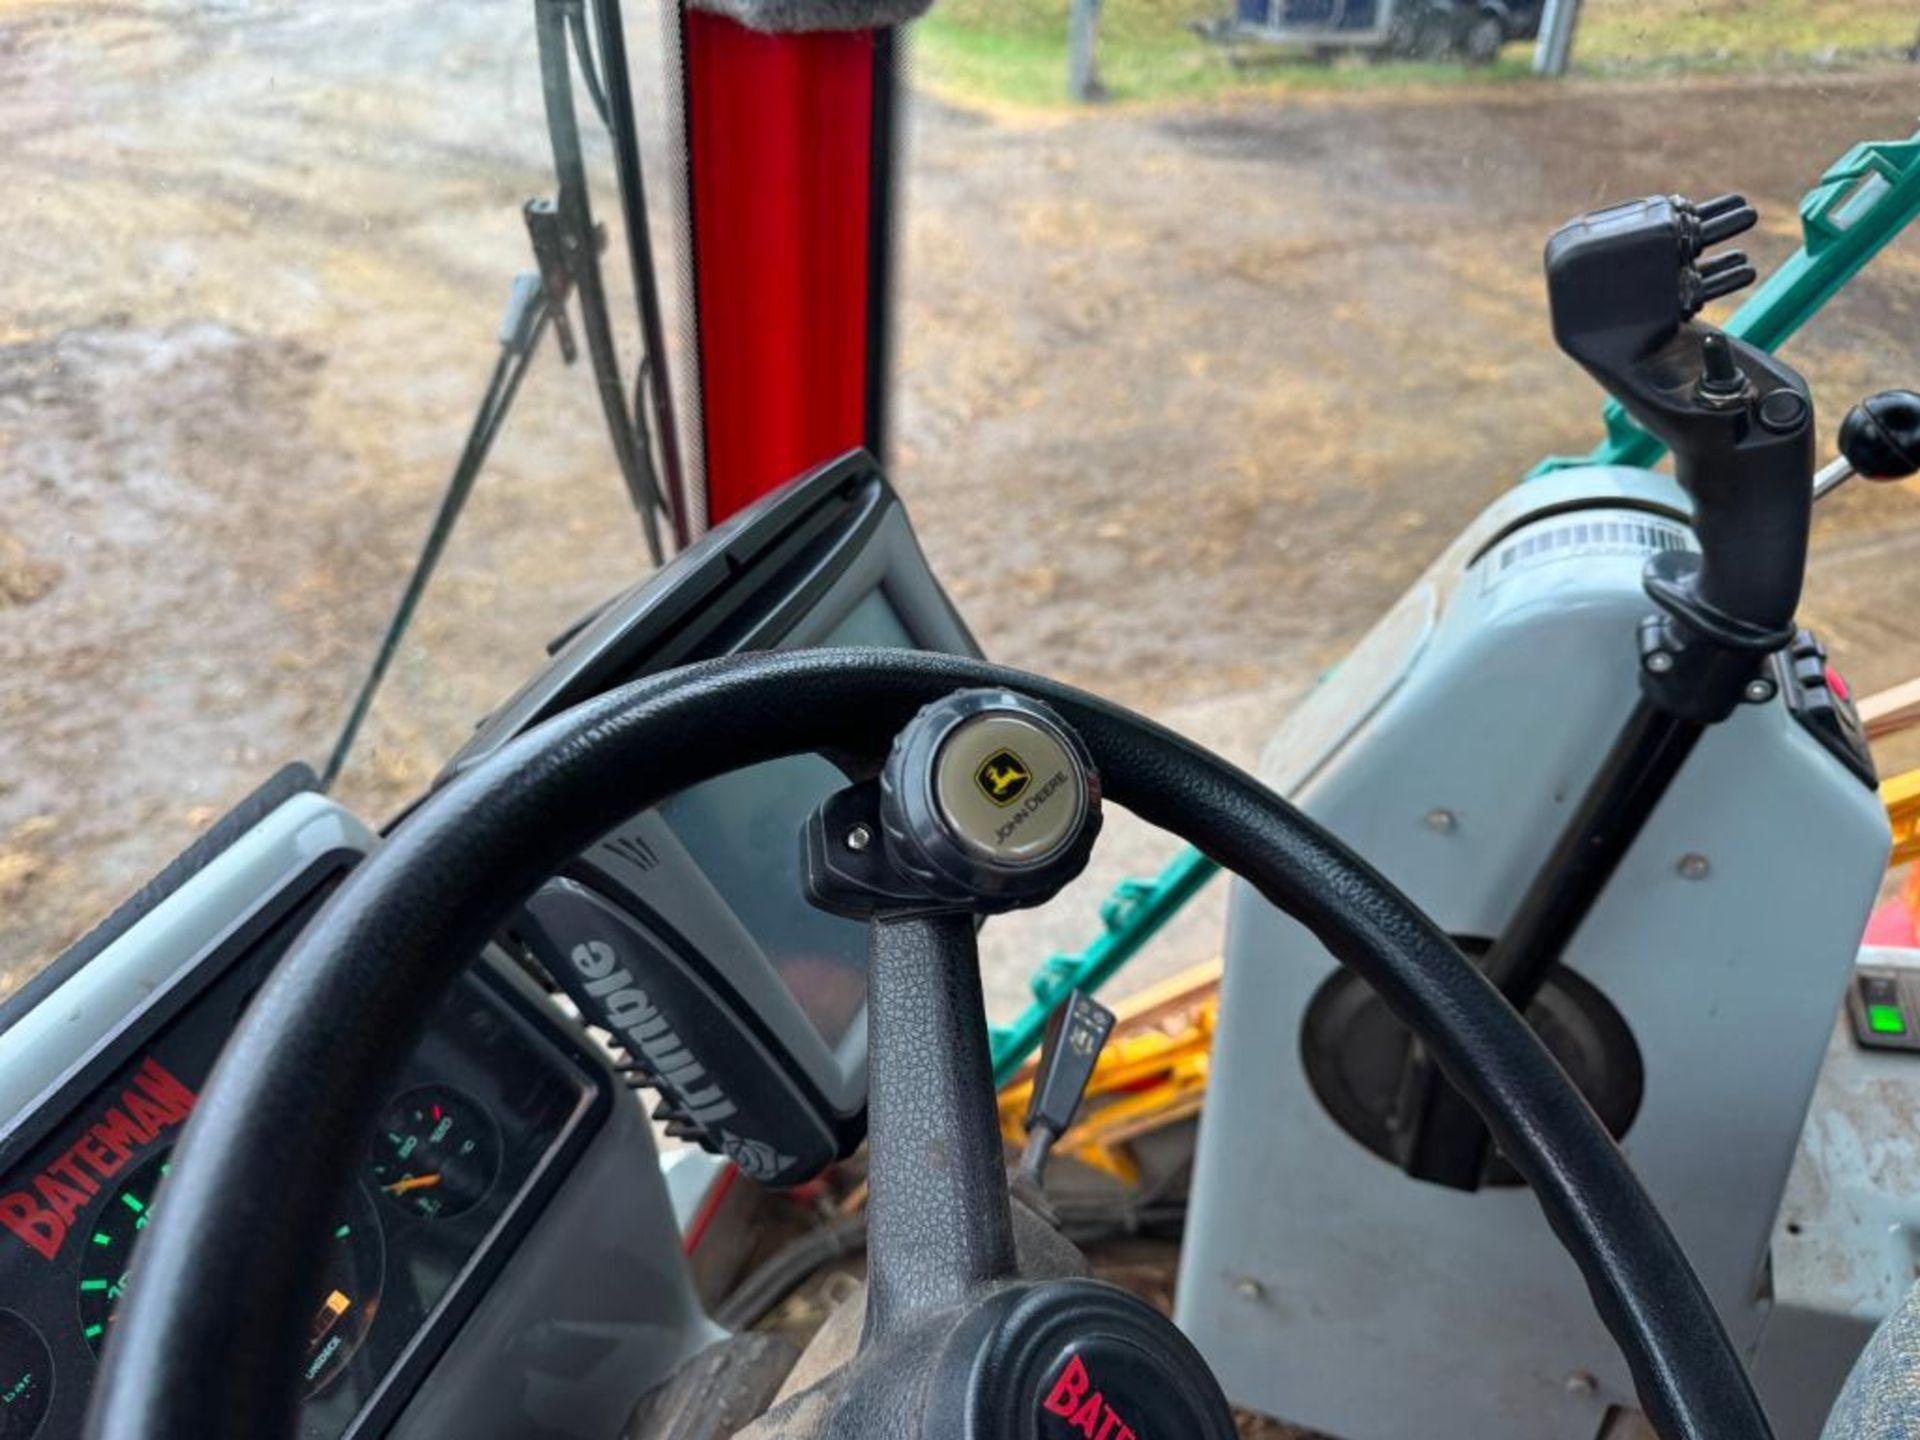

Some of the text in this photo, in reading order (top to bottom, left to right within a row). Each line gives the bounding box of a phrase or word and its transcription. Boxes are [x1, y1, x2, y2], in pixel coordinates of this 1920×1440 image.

[995, 770, 1068, 844] JOHN DEERE
[570, 940, 738, 1123] Trimble
[0, 1056, 199, 1260] BATEMAN
